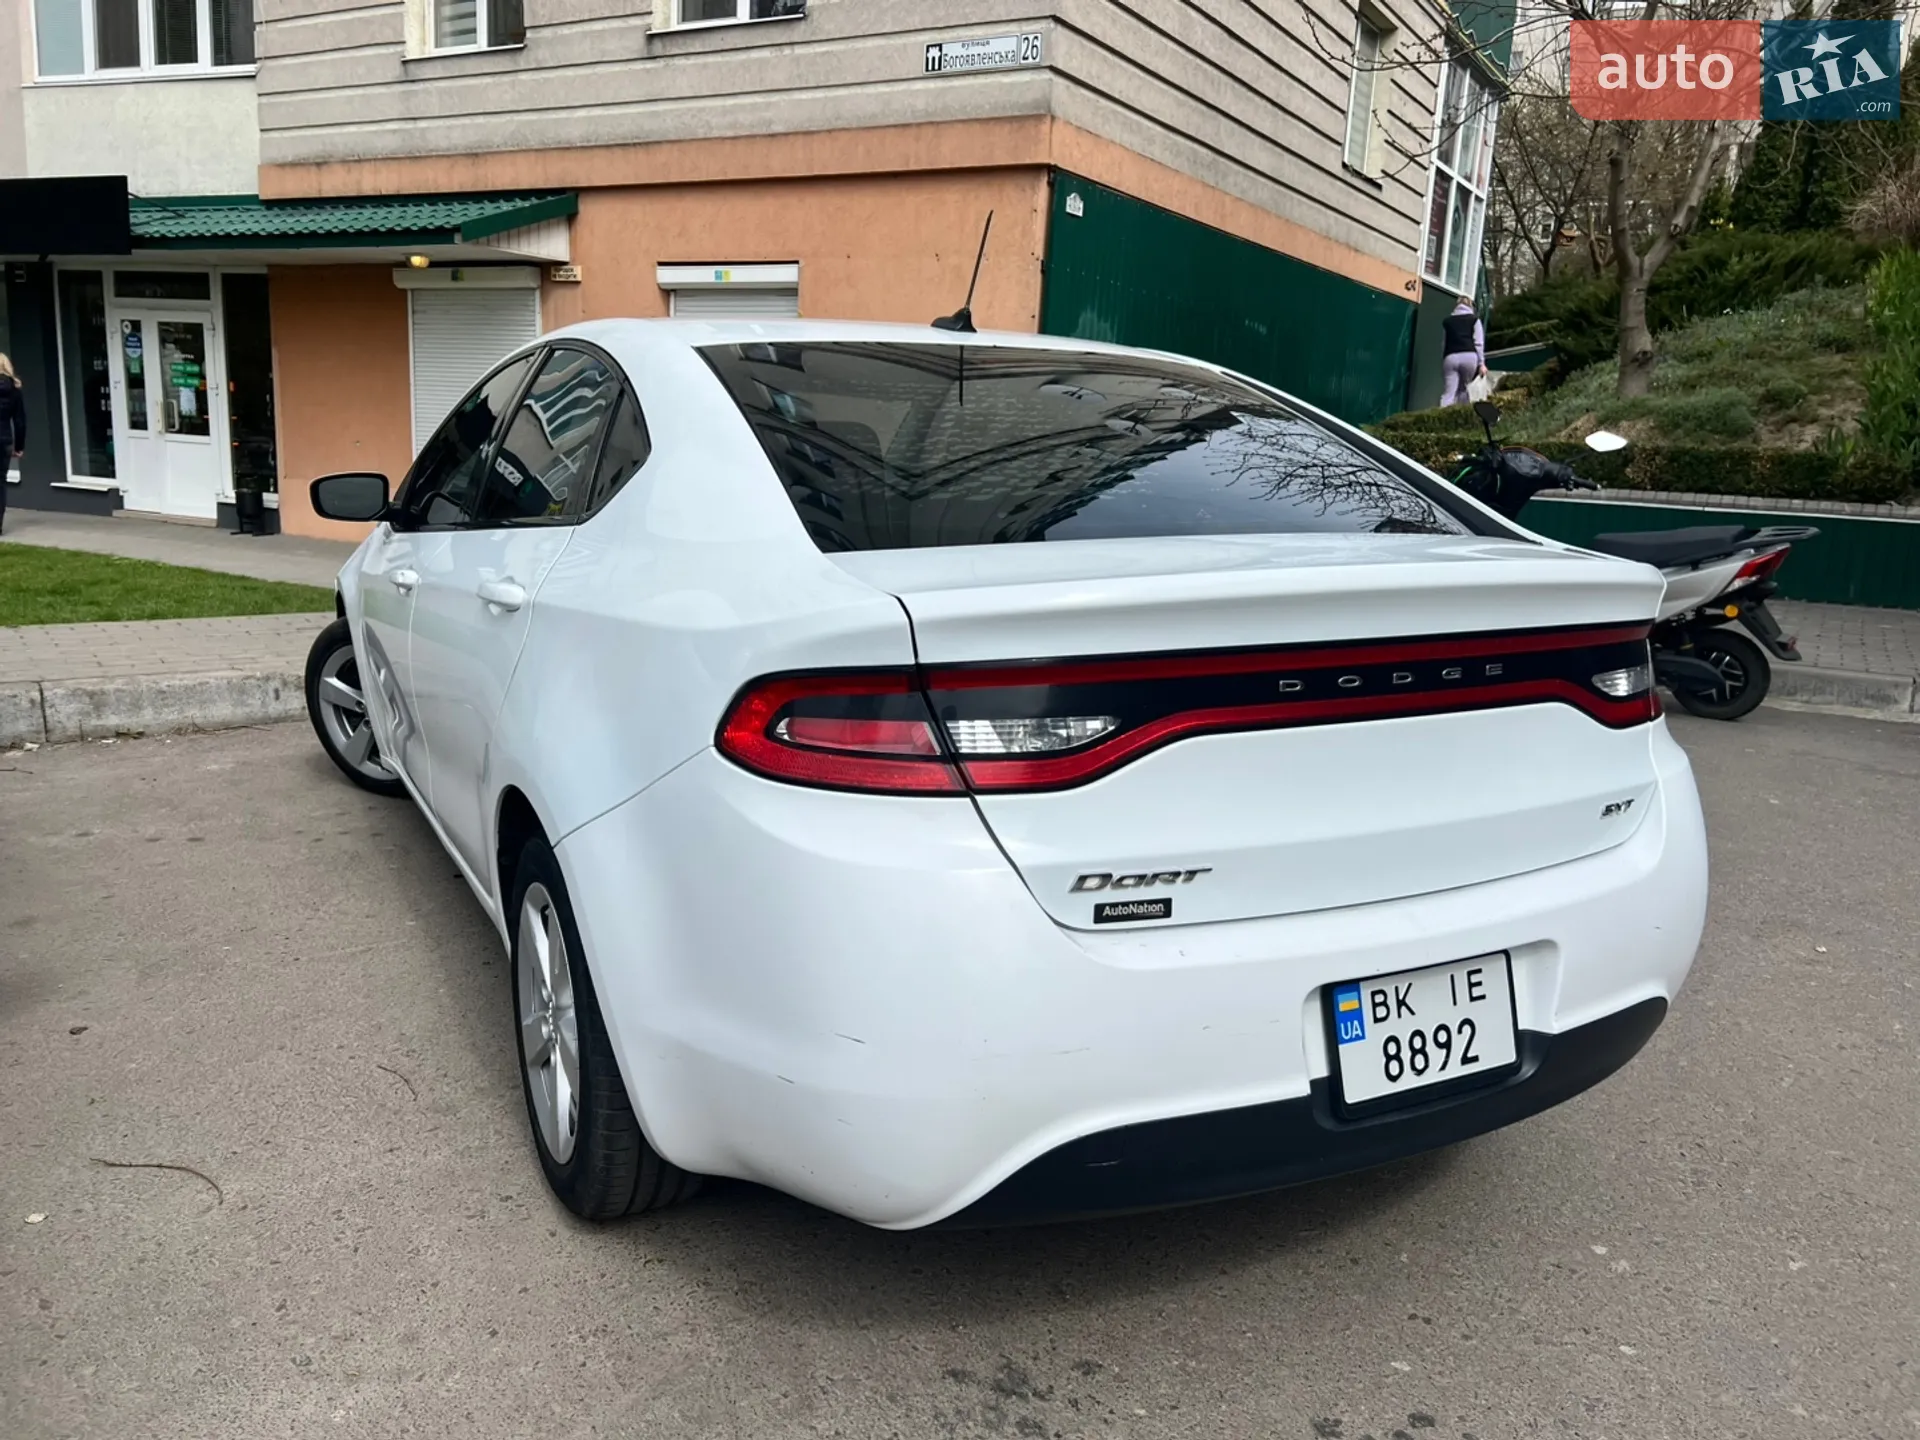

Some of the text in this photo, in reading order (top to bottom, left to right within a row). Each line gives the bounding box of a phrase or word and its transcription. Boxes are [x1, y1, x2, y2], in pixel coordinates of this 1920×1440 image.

[961, 40, 991, 51] вулиця
[1021, 35, 1040, 62] 26
[942, 48, 1016, 69] Богоявленська
[1278, 663, 1503, 693] DODGE
[1102, 902, 1165, 917] AutoNation
[1370, 967, 1487, 1024] BK IE
[1340, 1019, 1362, 1040] UA
[1382, 1017, 1480, 1083] 8892
